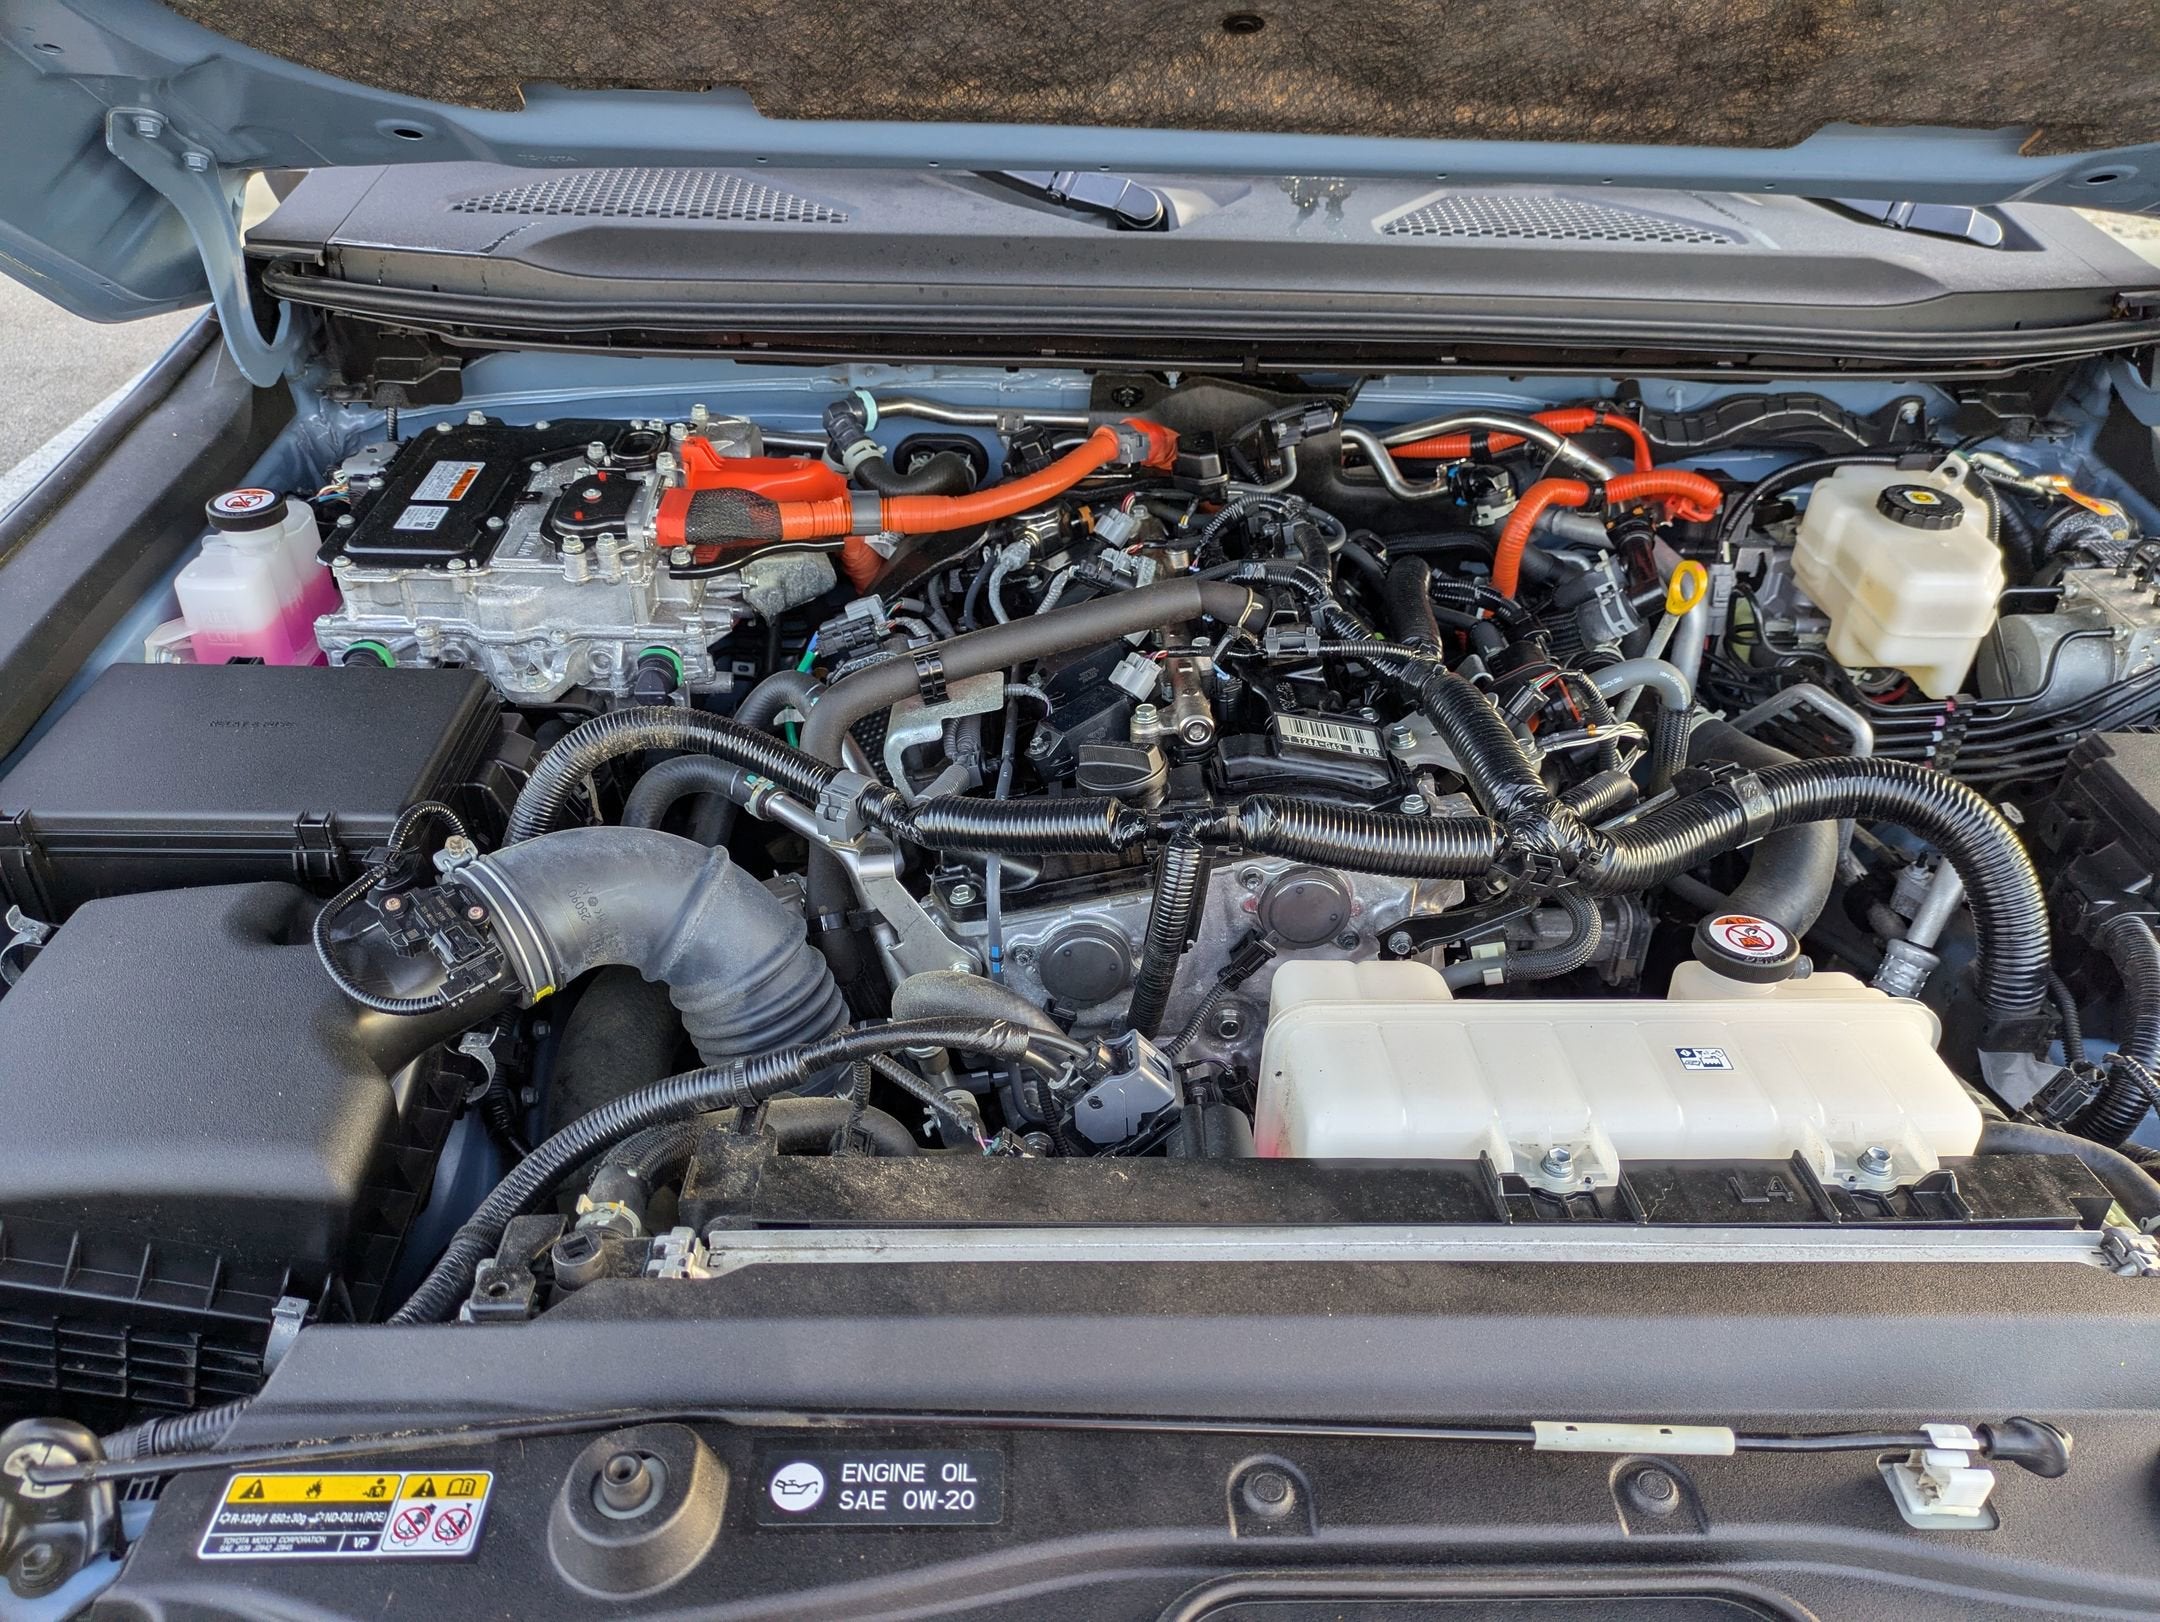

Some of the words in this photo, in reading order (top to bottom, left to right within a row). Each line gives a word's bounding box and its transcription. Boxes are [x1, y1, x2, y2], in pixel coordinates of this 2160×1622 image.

[842, 1463, 926, 1482] ENGINE
[941, 1463, 978, 1482] OIL
[838, 1490, 887, 1510] SAE
[903, 1490, 975, 1510] 0W-20
[223, 1536, 250, 1544] TOYOTA
[252, 1536, 278, 1544] MOTOR
[279, 1535, 327, 1544] CORPORATION
[353, 1537, 370, 1549] VP
